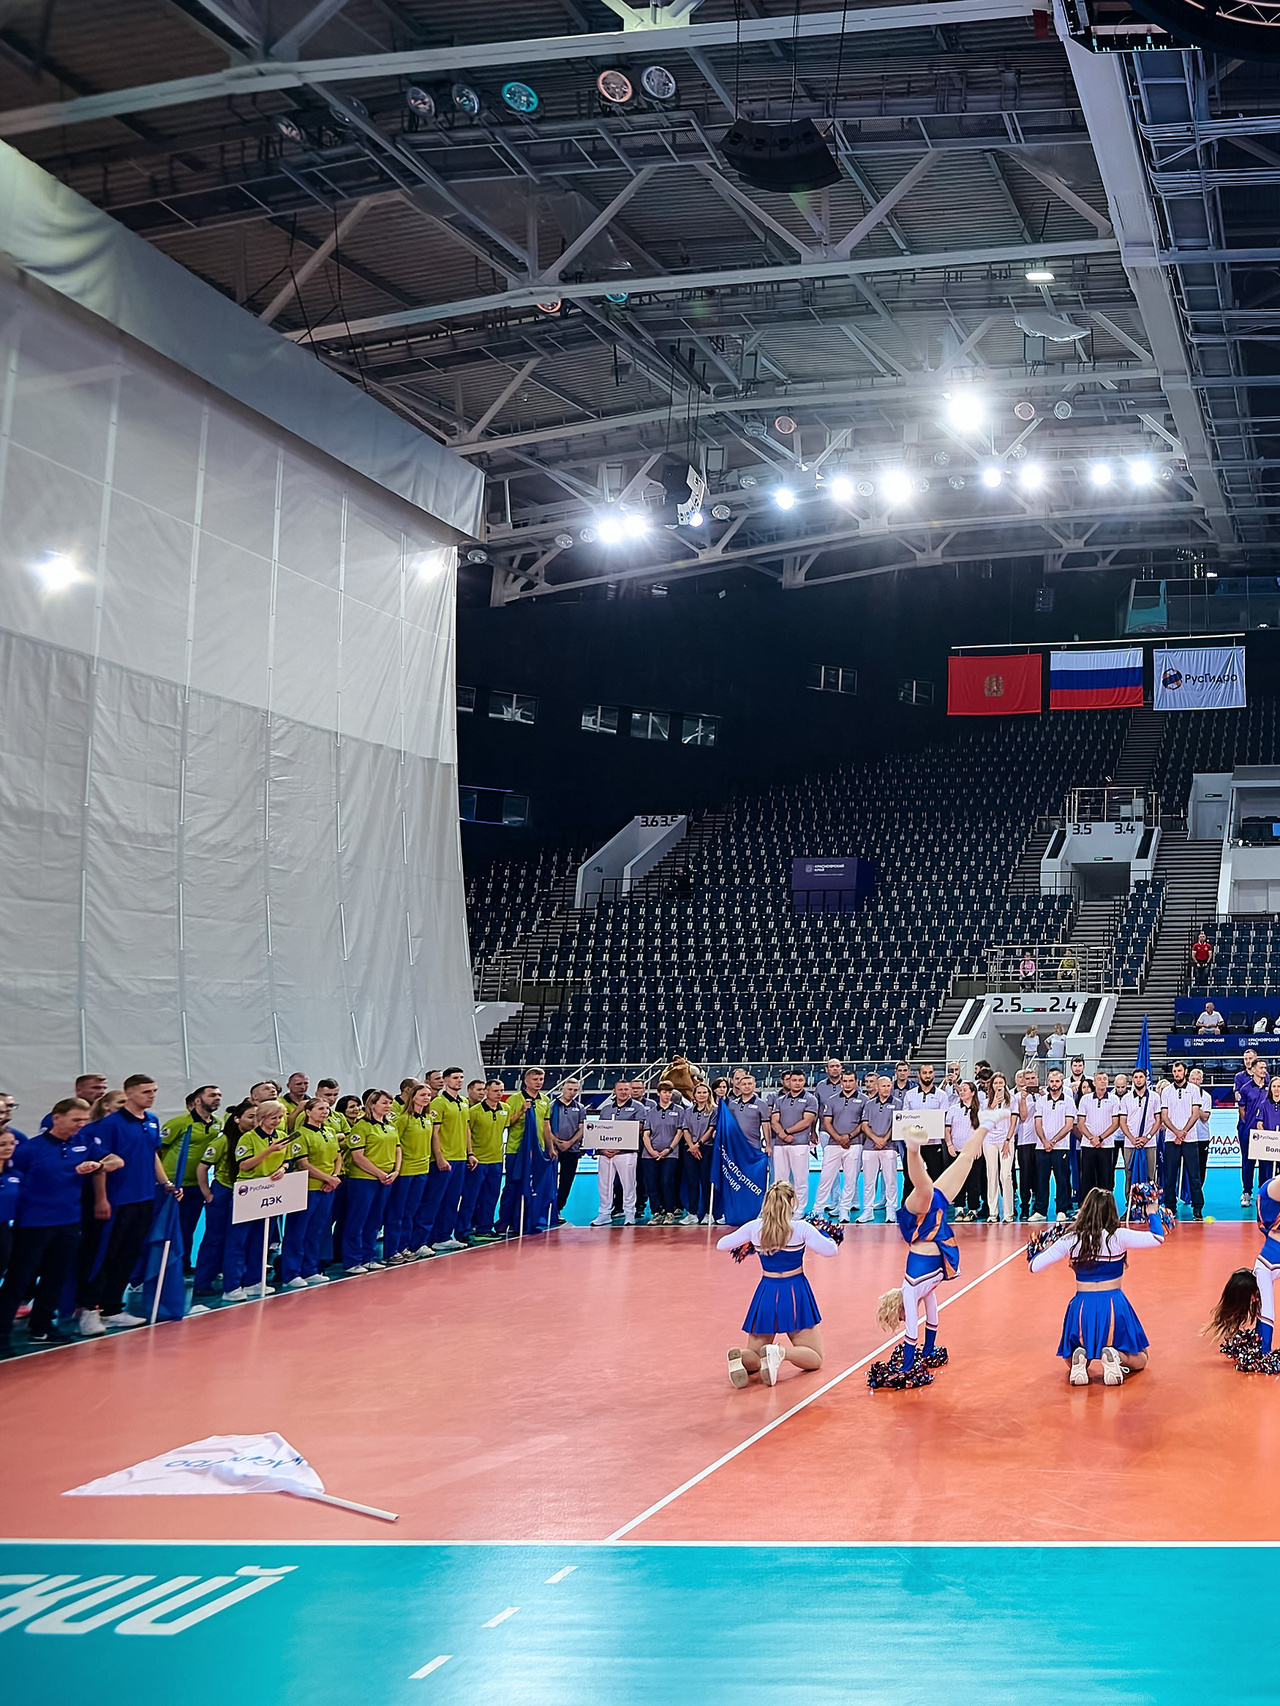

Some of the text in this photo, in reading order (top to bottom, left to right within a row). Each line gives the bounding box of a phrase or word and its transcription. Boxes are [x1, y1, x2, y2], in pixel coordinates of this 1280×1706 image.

[1184, 672, 1238, 685] РусГидро
[641, 816, 659, 828] 3.6
[1072, 822, 1136, 835] 3.5 3.4
[992, 997, 1078, 1013] 2.5 2.4
[599, 1135, 623, 1143] Центр
[260, 1194, 283, 1208] ДЭК
